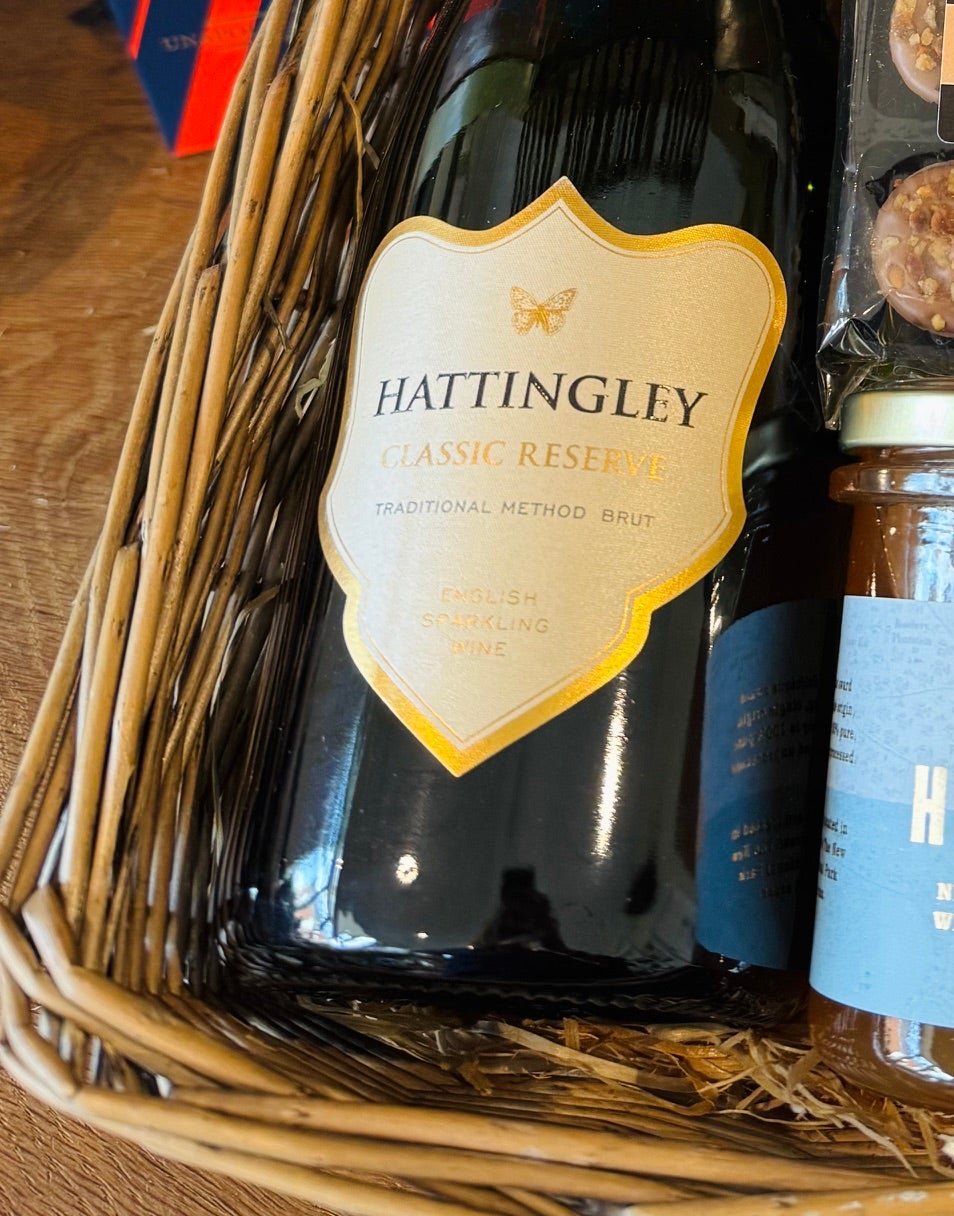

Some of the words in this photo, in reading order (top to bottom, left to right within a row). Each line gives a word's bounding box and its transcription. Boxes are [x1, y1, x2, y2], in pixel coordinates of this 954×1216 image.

[373, 370, 709, 429] HATTINGLEY
[381, 440, 506, 470] CLASSIC
[517, 441, 668, 482] RESERVE
[375, 499, 492, 517] TRADITIONAL
[501, 501, 587, 520] METHOD
[601, 508, 656, 528] BRUT
[439, 588, 538, 606] ENGLISH
[421, 612, 549, 634] SPARKLING
[452, 641, 507, 657] WINE
